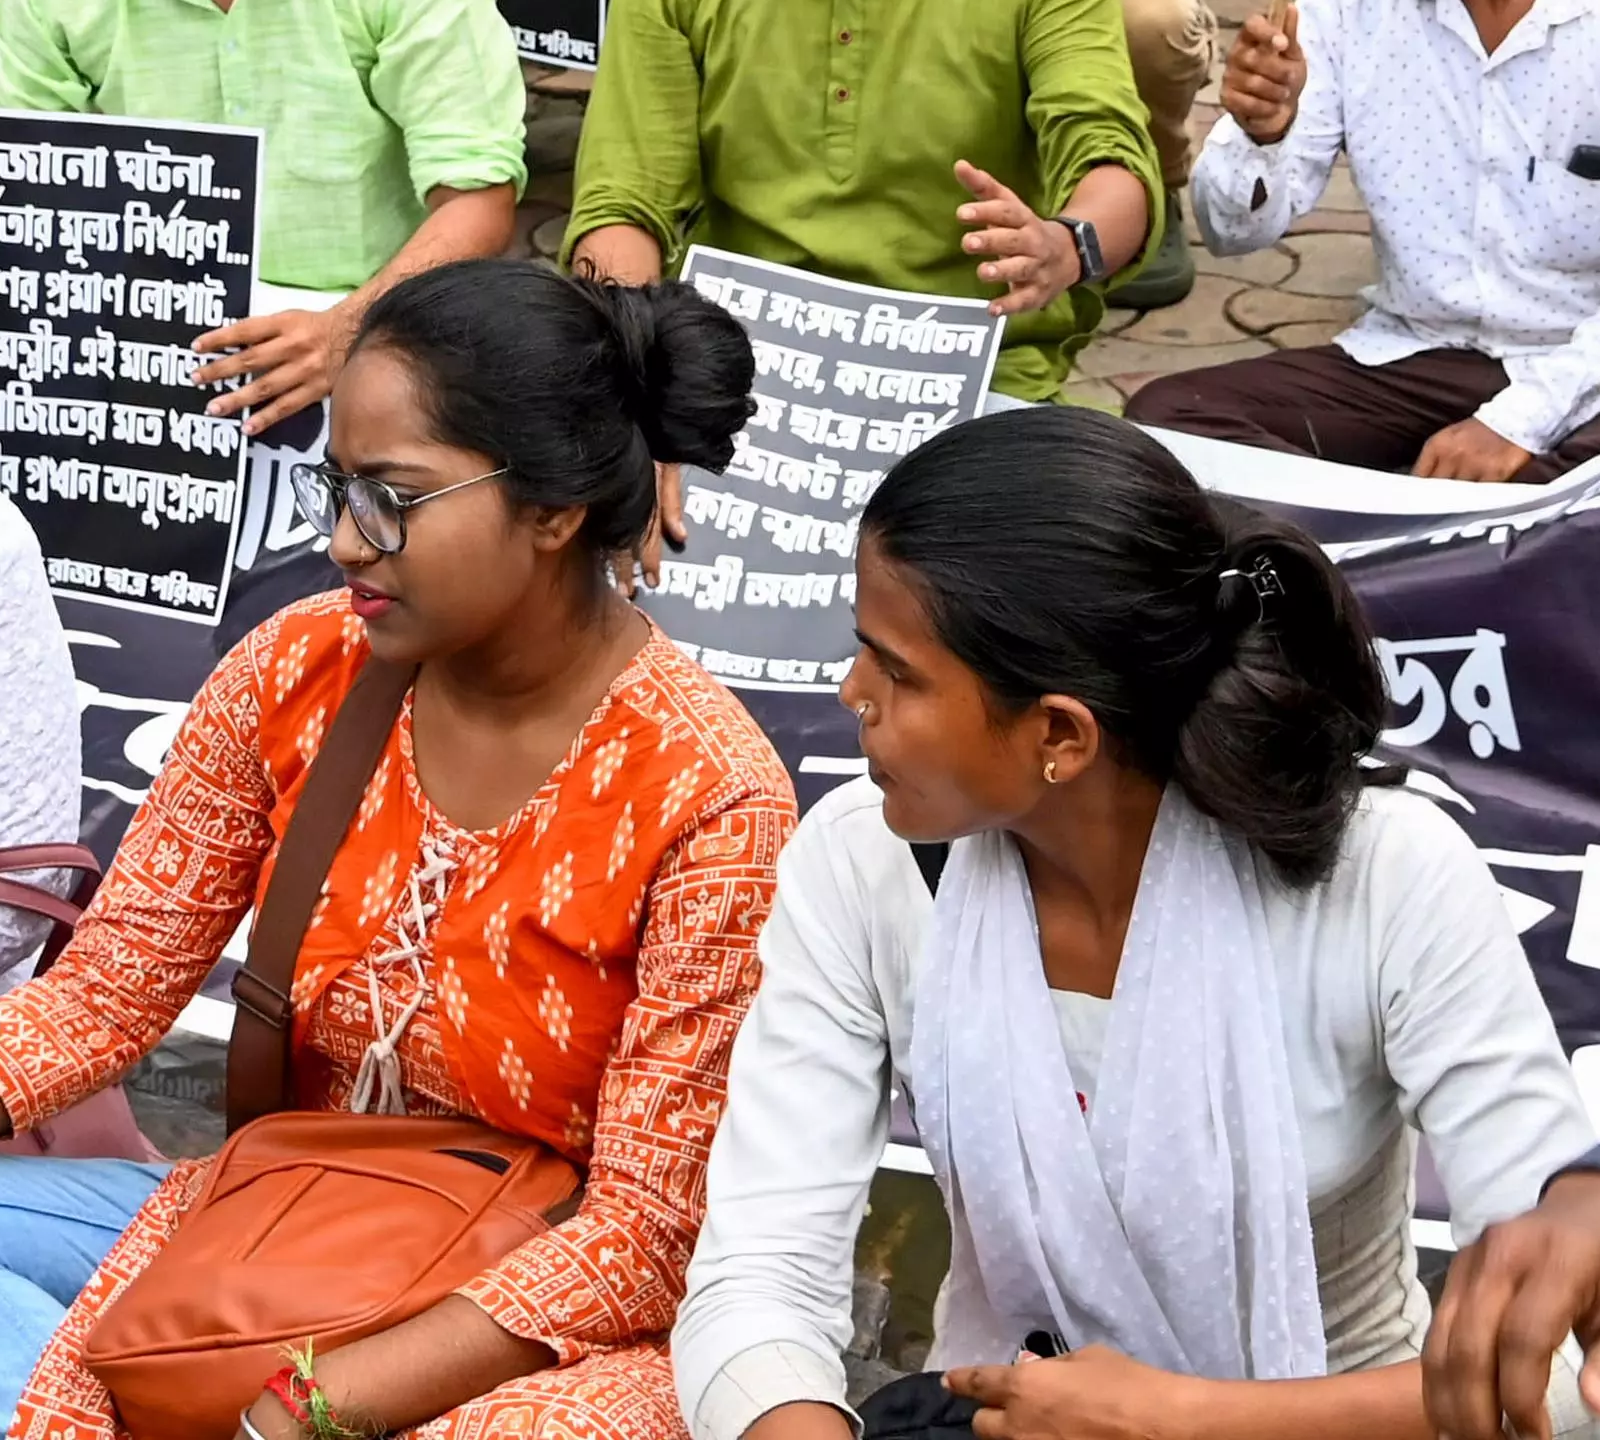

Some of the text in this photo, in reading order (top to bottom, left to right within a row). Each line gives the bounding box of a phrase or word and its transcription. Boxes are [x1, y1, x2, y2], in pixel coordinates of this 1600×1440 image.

[56, 209, 121, 269] মূল্য
[44, 269, 127, 318] প্রমাণ
[766, 291, 861, 343] সংসদ
[859, 303, 989, 358] নির্বাচন
[72, 325, 116, 381] এই
[833, 360, 967, 407] কলেজে
[111, 402, 166, 447] মত
[788, 403, 867, 452] ছাত্র
[24, 455, 101, 504] প্রধান
[683, 485, 760, 540] কার
[47, 557, 219, 610] রাজ্য ছাত্র পরিষদ
